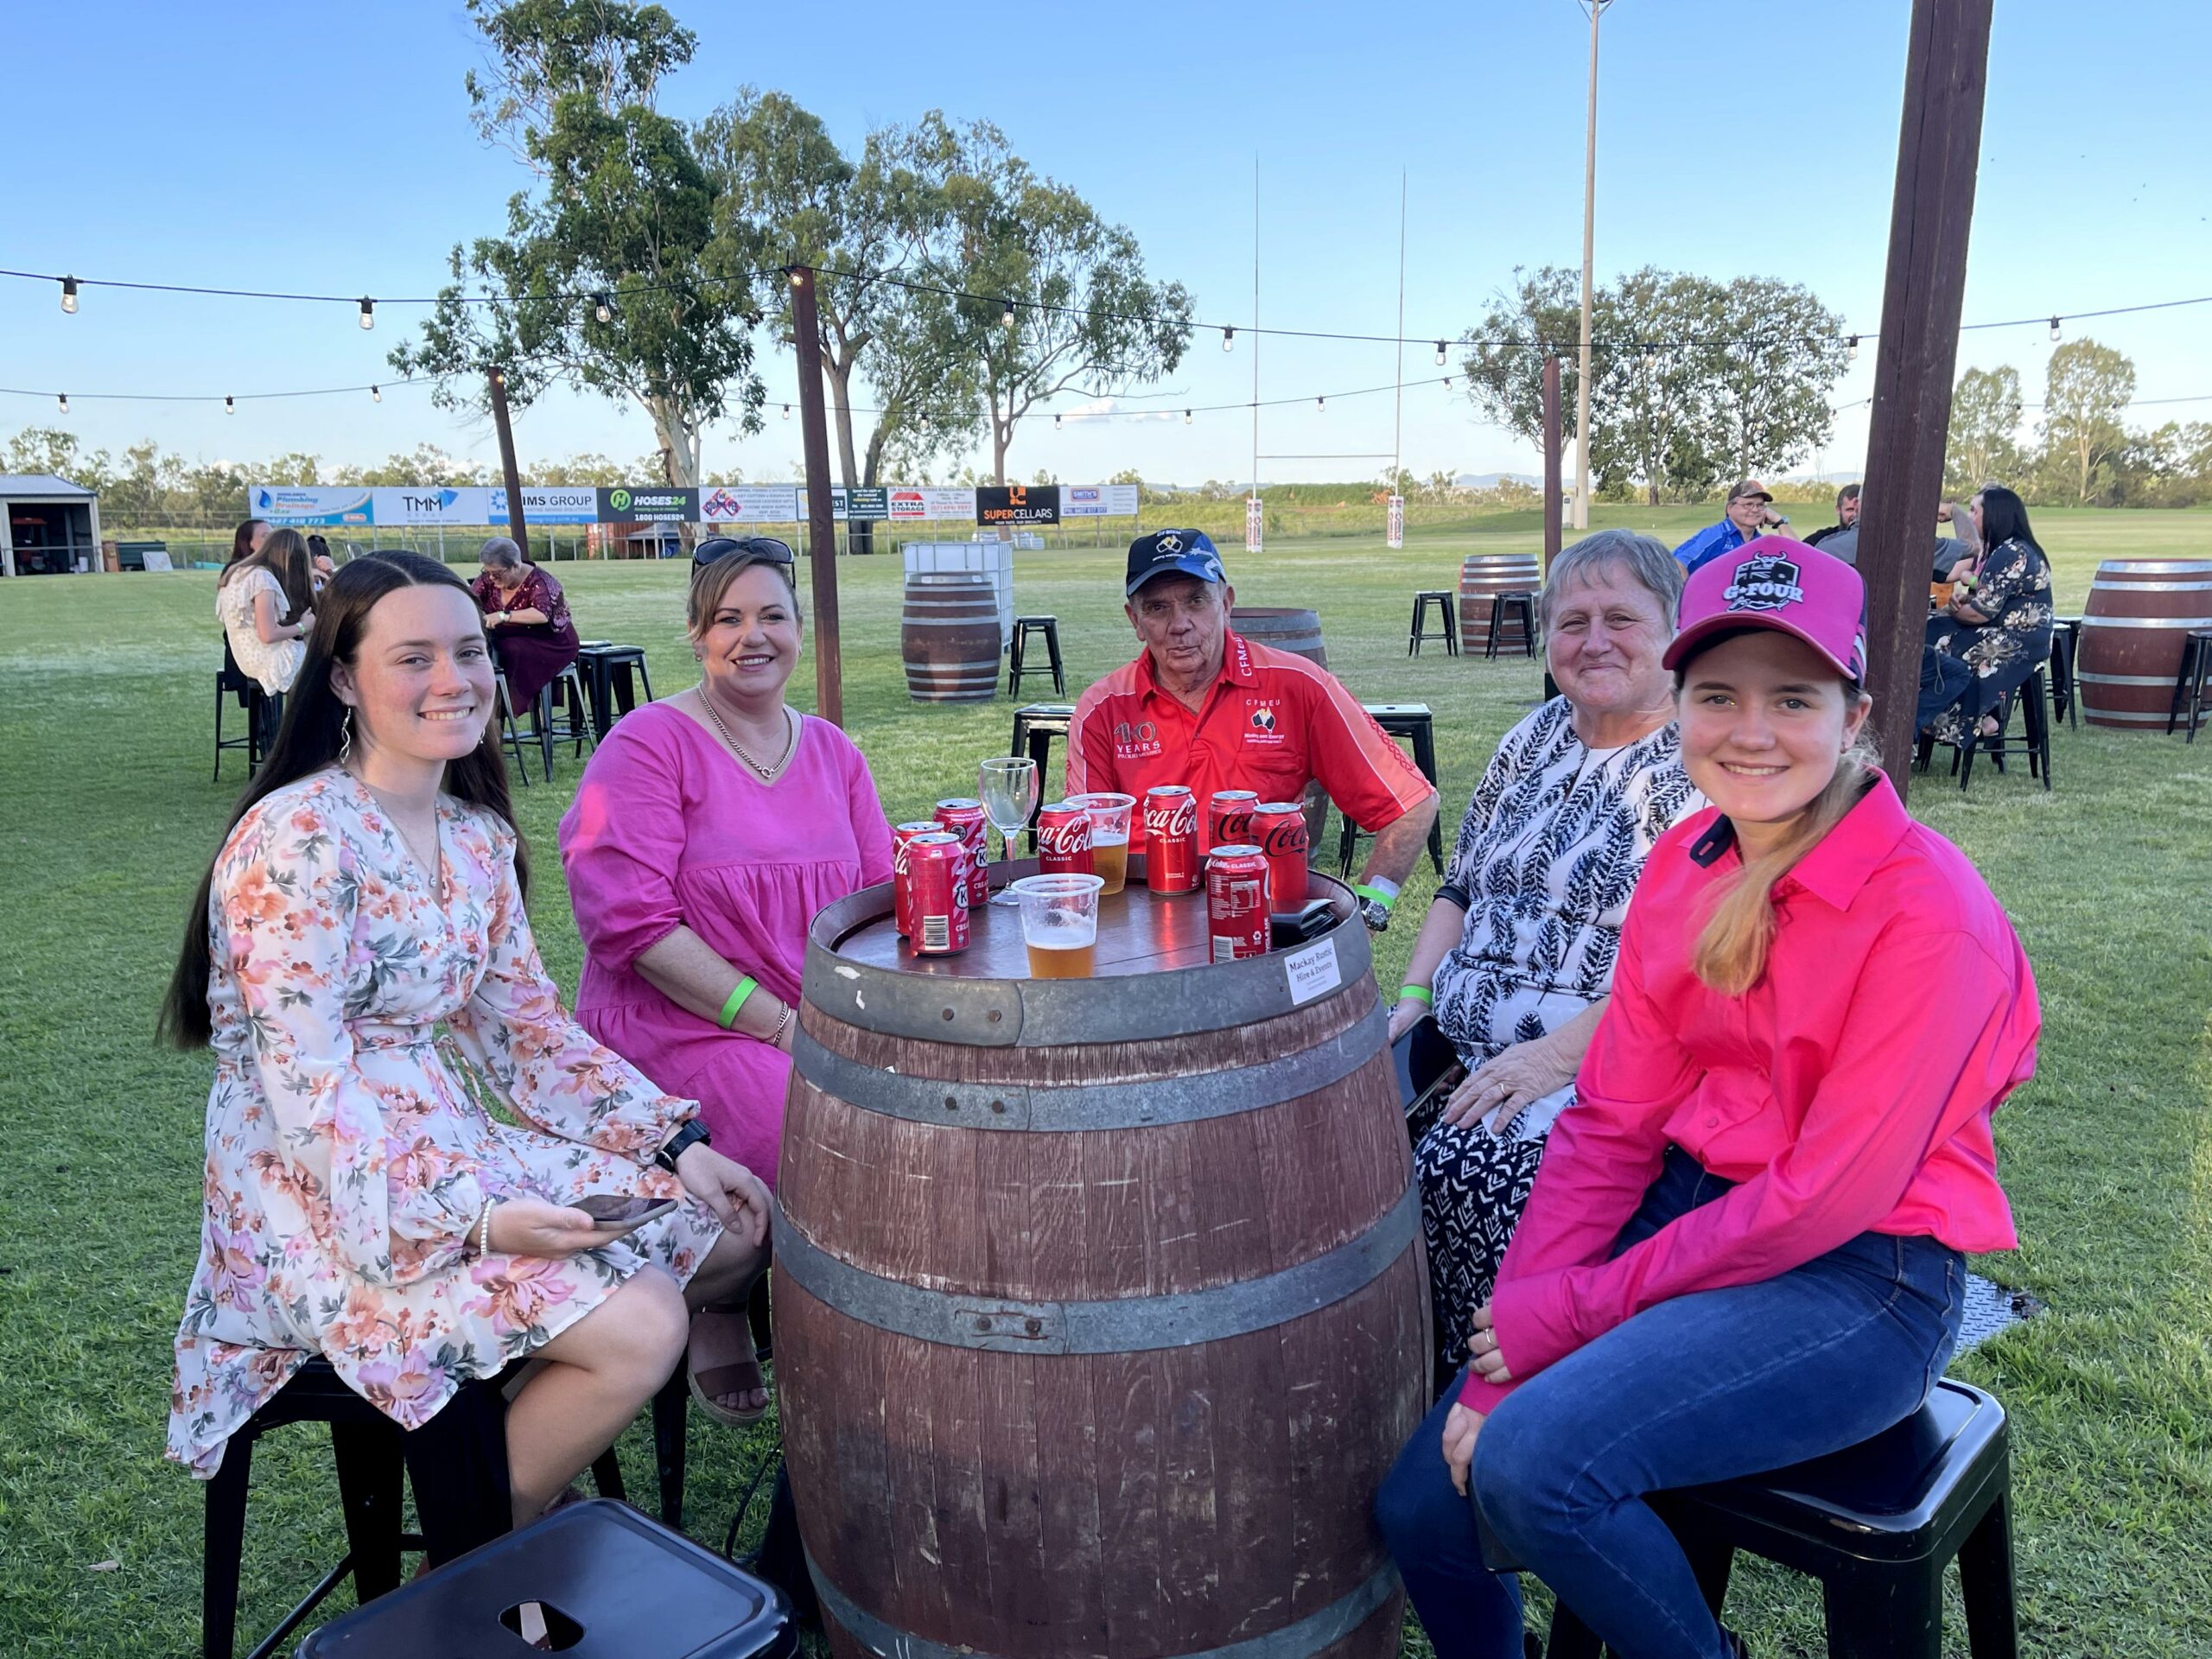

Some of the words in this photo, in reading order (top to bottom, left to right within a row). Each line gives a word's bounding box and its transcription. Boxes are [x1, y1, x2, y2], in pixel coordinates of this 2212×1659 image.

[402, 497, 442, 512] TMM
[550, 496, 592, 505] GROUP
[634, 496, 686, 505] HOSES24
[983, 508, 1052, 520] SUPERCELLARS
[1233, 636, 1252, 677] CFMEU
[1116, 741, 1160, 753] YEARS
[1289, 956, 1315, 972] Mackay
[1296, 971, 1310, 982] Hire
[1315, 962, 1332, 975] Events
